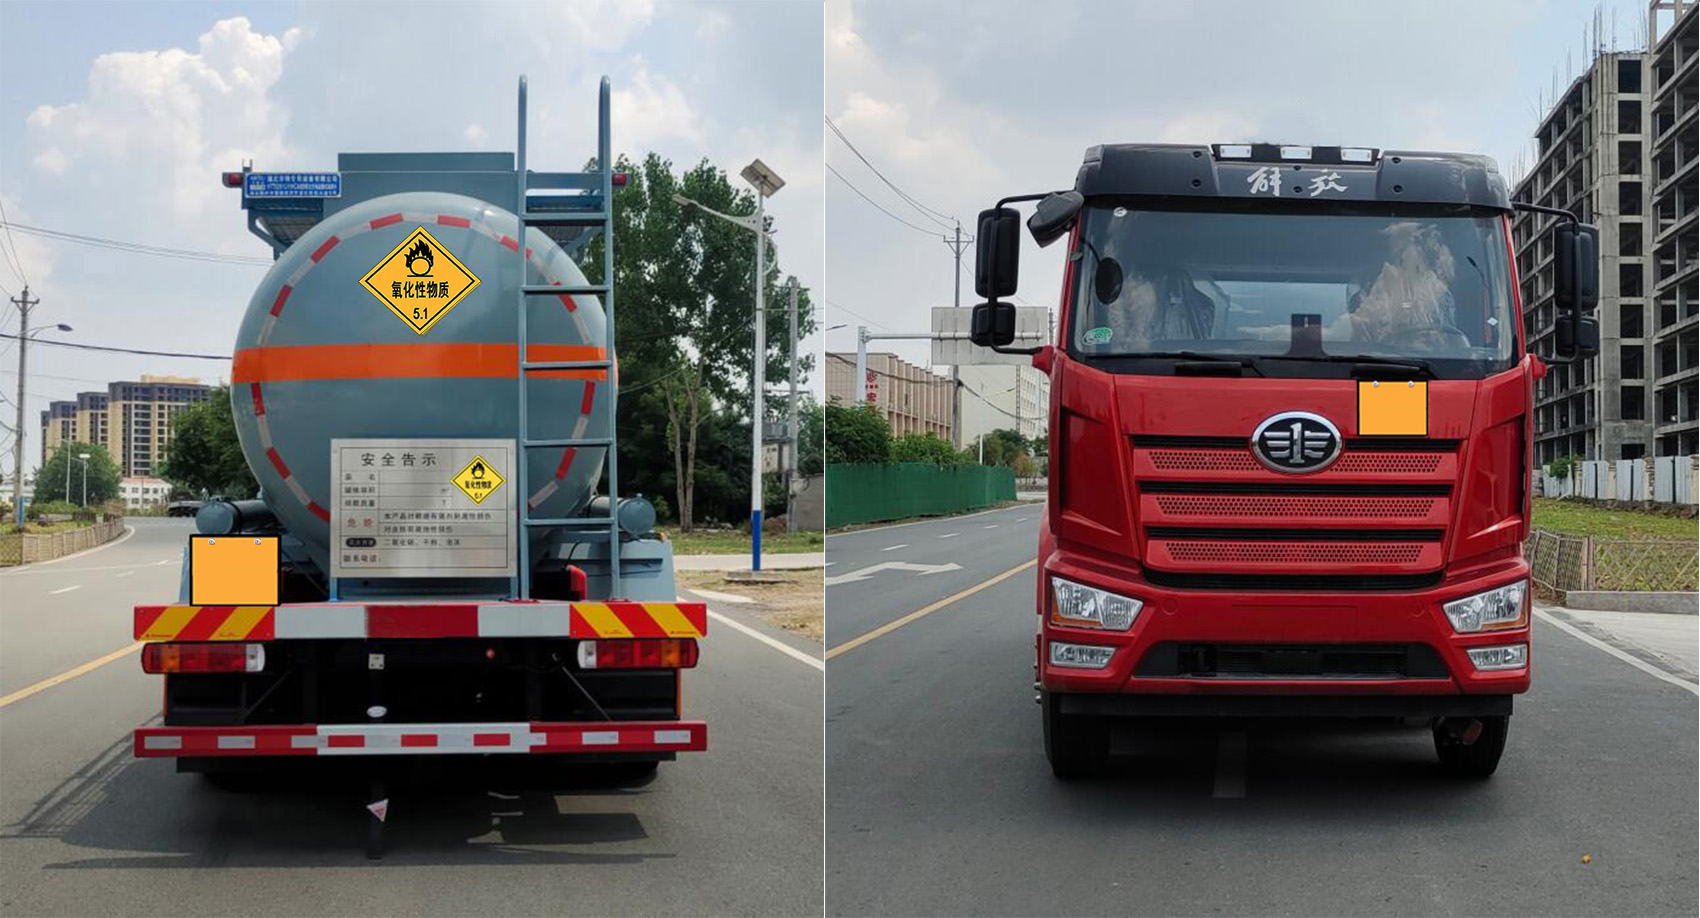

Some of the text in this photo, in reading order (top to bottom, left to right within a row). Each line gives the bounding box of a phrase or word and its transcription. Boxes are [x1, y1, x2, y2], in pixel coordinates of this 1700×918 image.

[391, 281, 449, 299] 氧化性物质
[413, 307, 428, 320] 5.1
[361, 452, 436, 467] 安全告示
